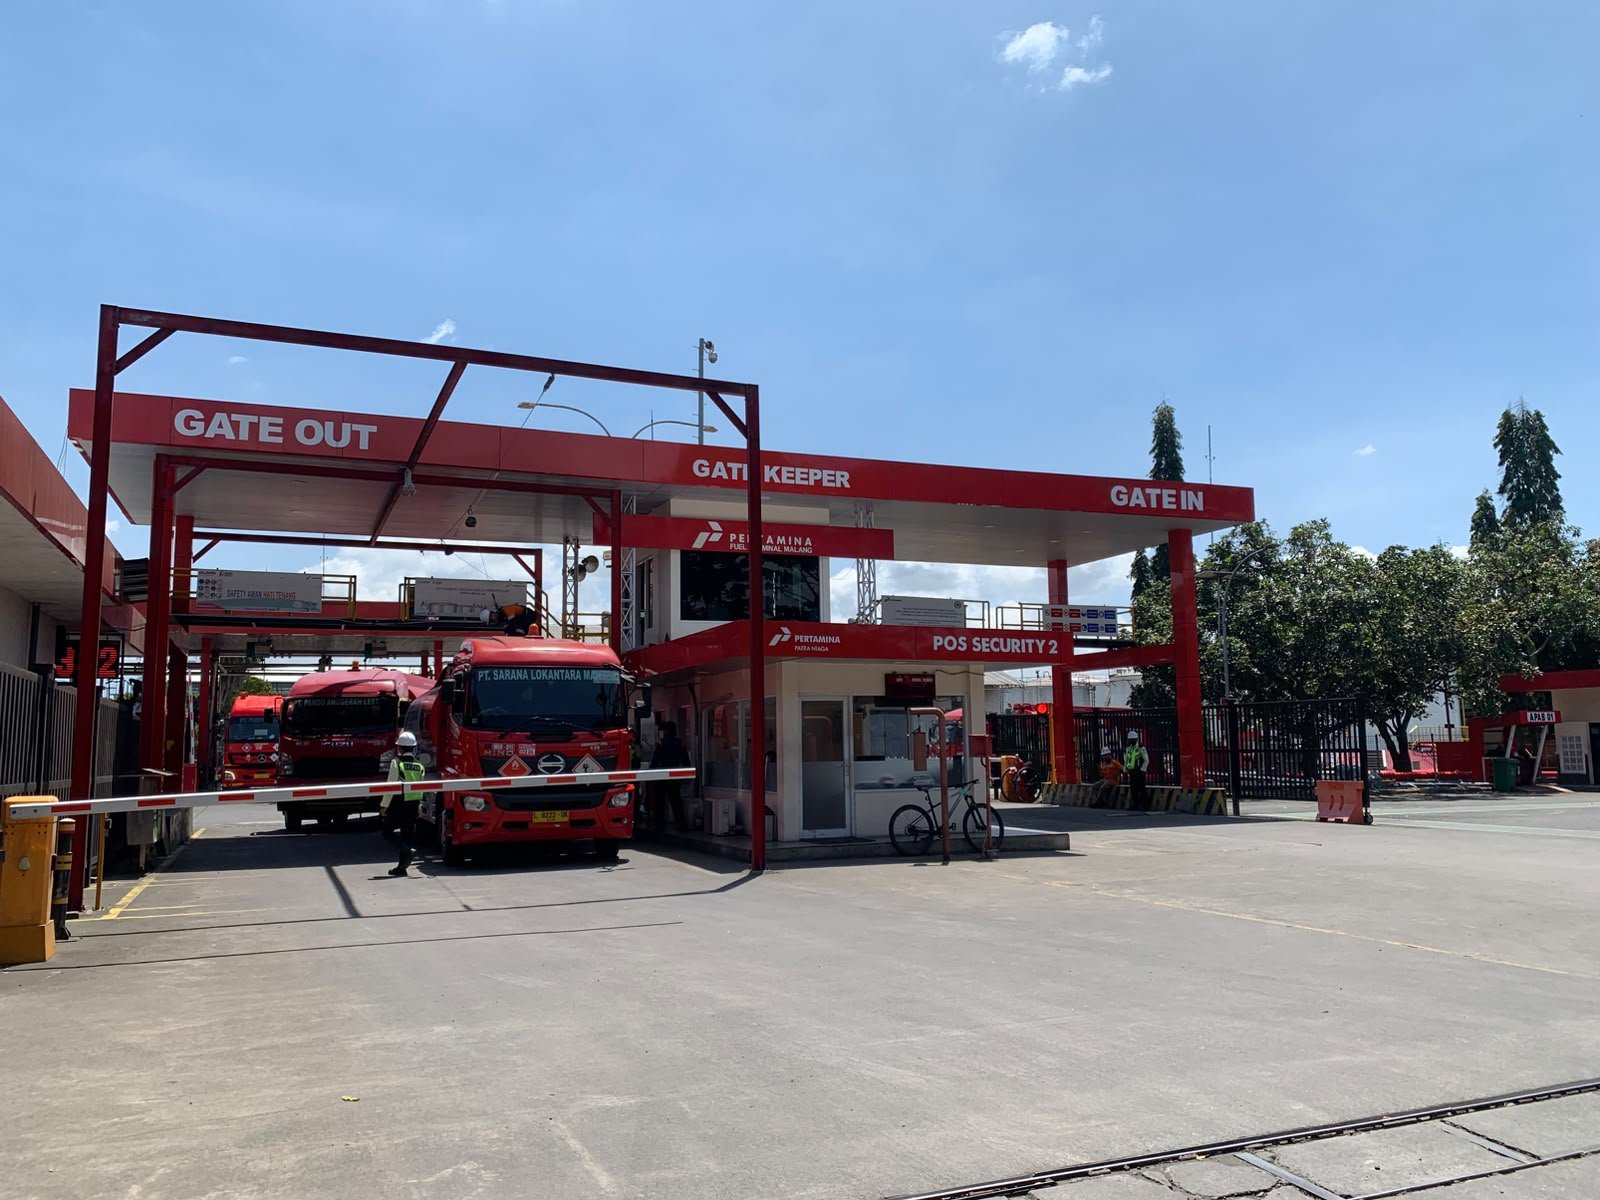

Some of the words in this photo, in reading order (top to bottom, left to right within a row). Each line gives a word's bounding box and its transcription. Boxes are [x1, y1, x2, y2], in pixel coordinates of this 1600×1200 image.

[174, 409, 283, 443] GATE
[295, 419, 377, 450] OUT
[764, 465, 850, 488] KEEPER
[1110, 485, 1177, 509] GATE
[1180, 490, 1204, 511] IN
[729, 533, 812, 546] PEAMINA
[729, 543, 747, 551] FUEL
[783, 546, 812, 554] MALANG
[226, 589, 246, 598] SAFETY
[247, 590, 262, 599] AMAN
[794, 635, 841, 644] PERTAMINA
[933, 635, 968, 652] POS
[972, 637, 1046, 654] SECURITY
[1048, 640, 1058, 654] 2
[478, 670, 491, 681] PT.
[493, 670, 529, 680] SARANA
[530, 669, 582, 680] LOKANTARA
